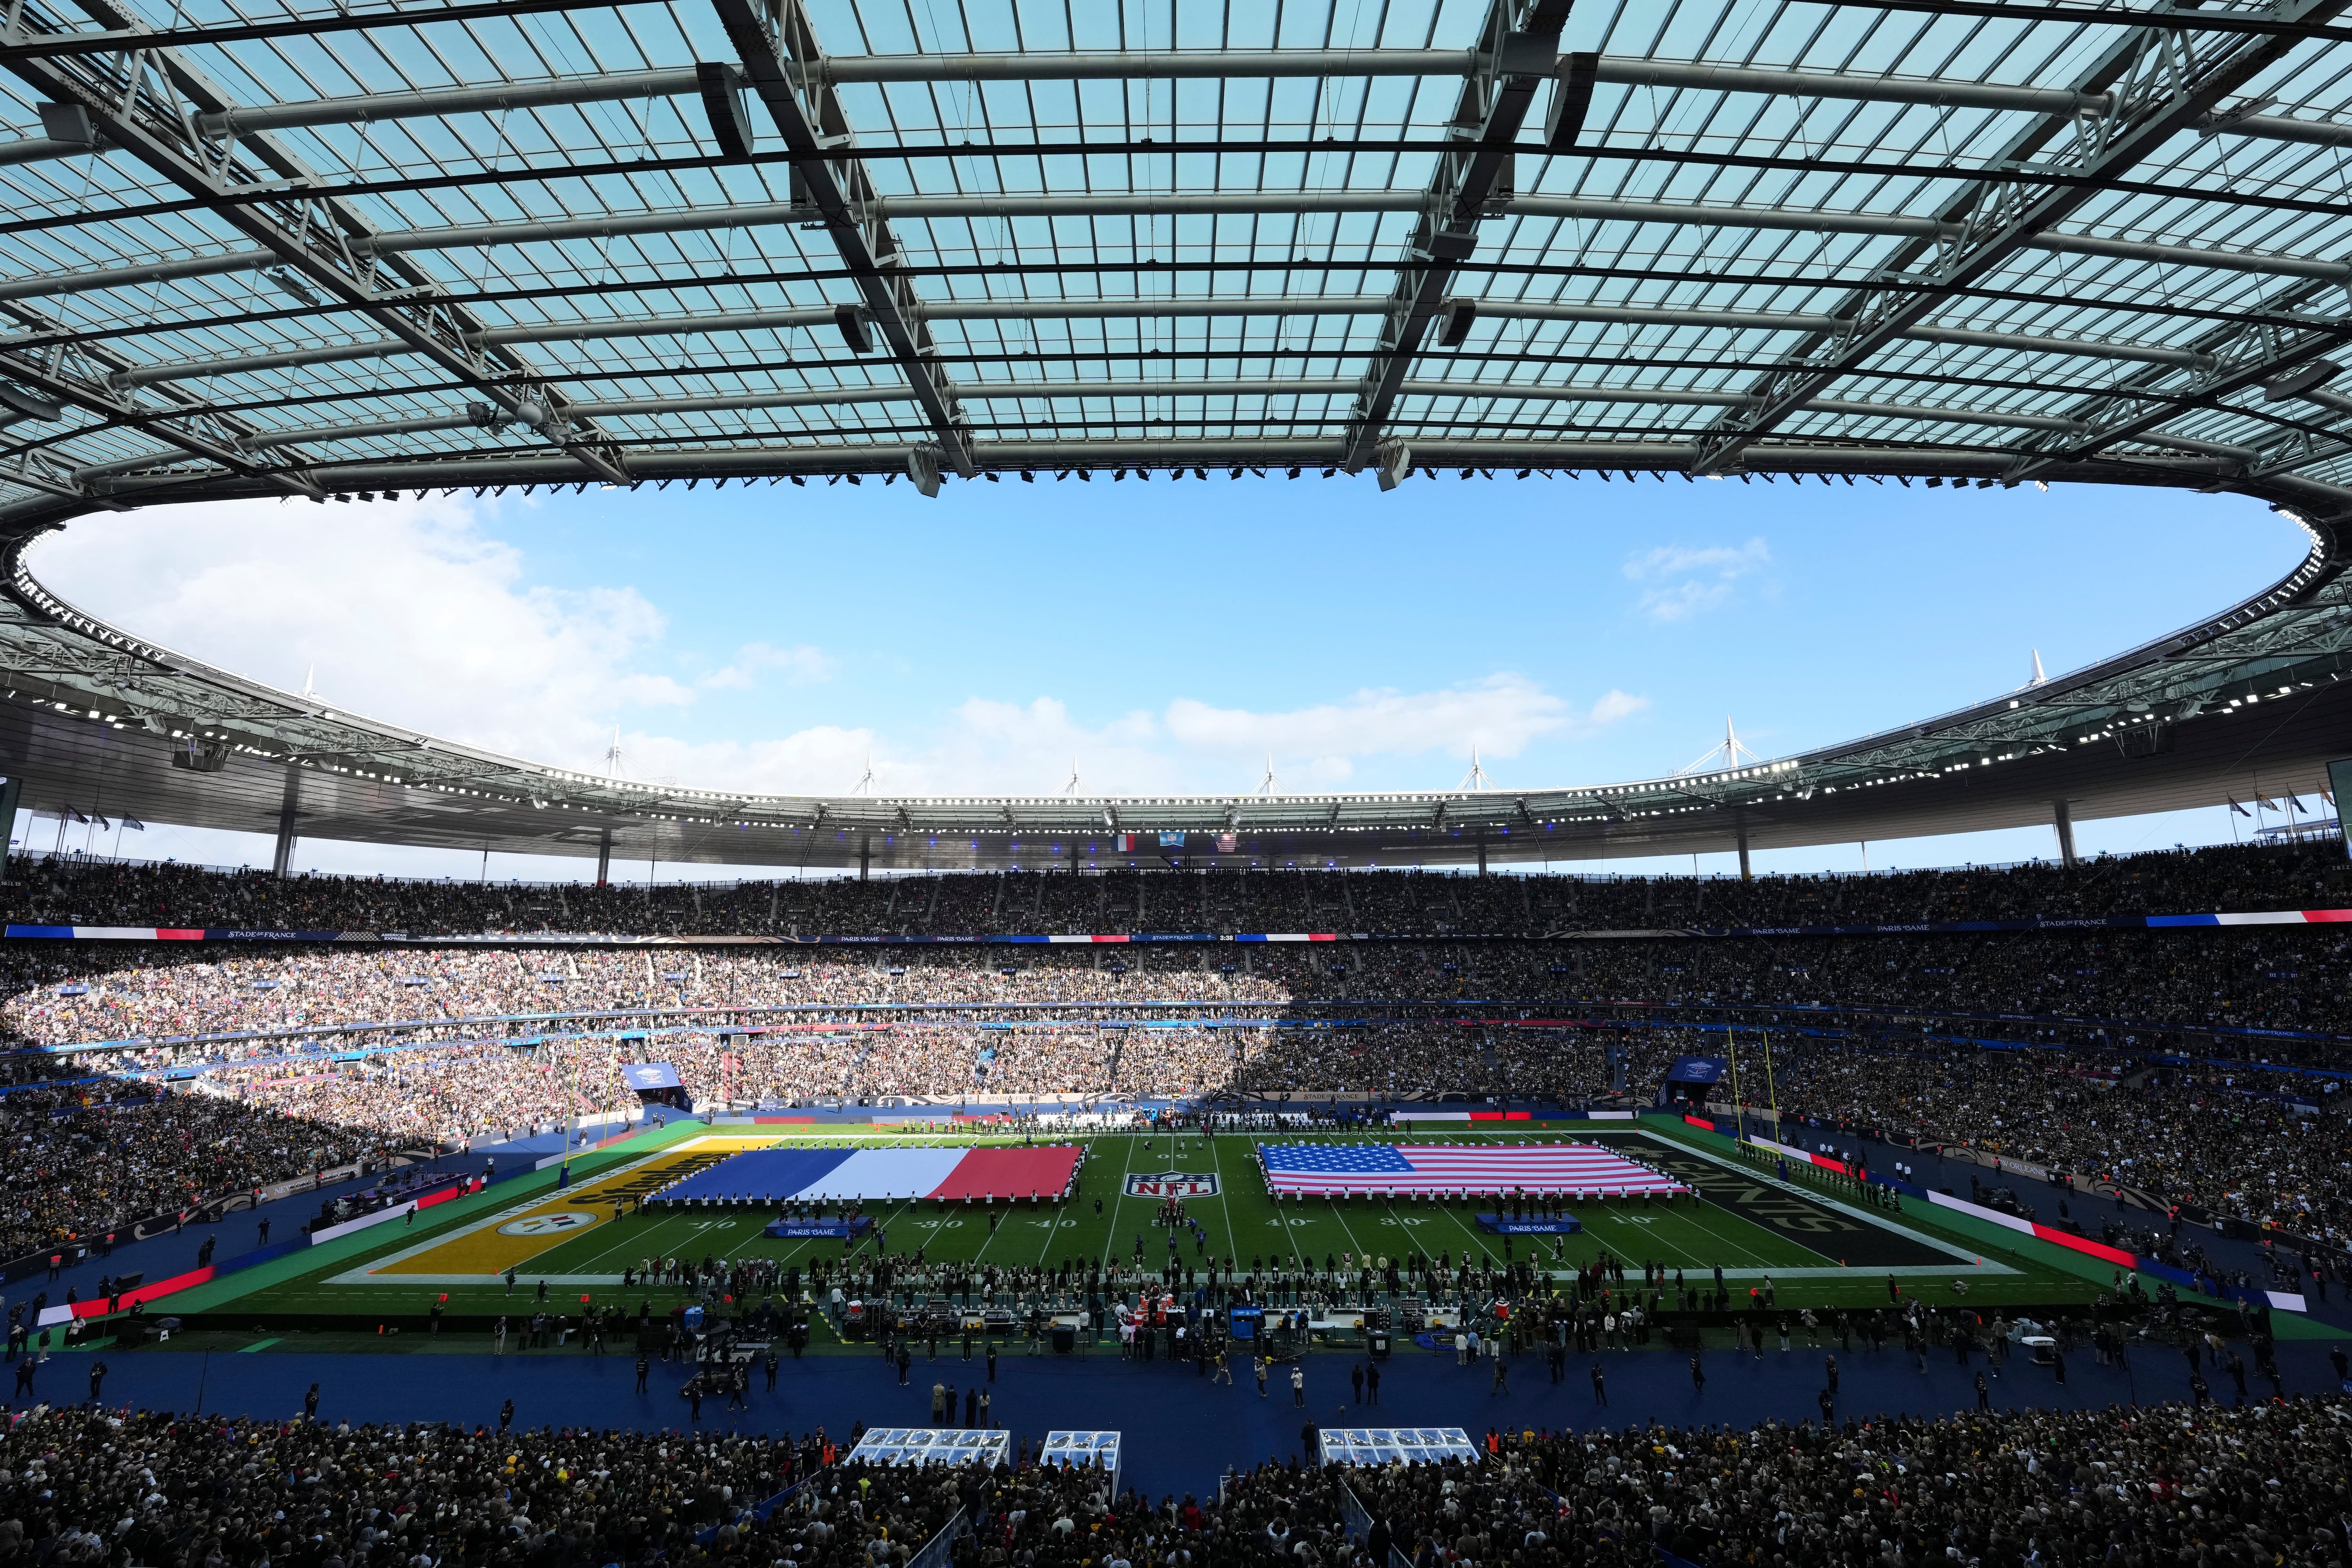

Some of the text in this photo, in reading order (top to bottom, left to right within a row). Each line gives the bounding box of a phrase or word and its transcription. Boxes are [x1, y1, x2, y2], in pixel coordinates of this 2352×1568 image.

[1990, 1157, 2046, 1176] NW ORLEANS
[274, 1183, 294, 1195] NEW
[518, 1190, 571, 1209] TAKES
[571, 1179, 600, 1188] ALL
[1136, 1183, 1208, 1194] NFL
[1717, 1162, 1836, 1204] INSPIRE CHANGE
[1655, 1162, 1865, 1232] SAINTS
